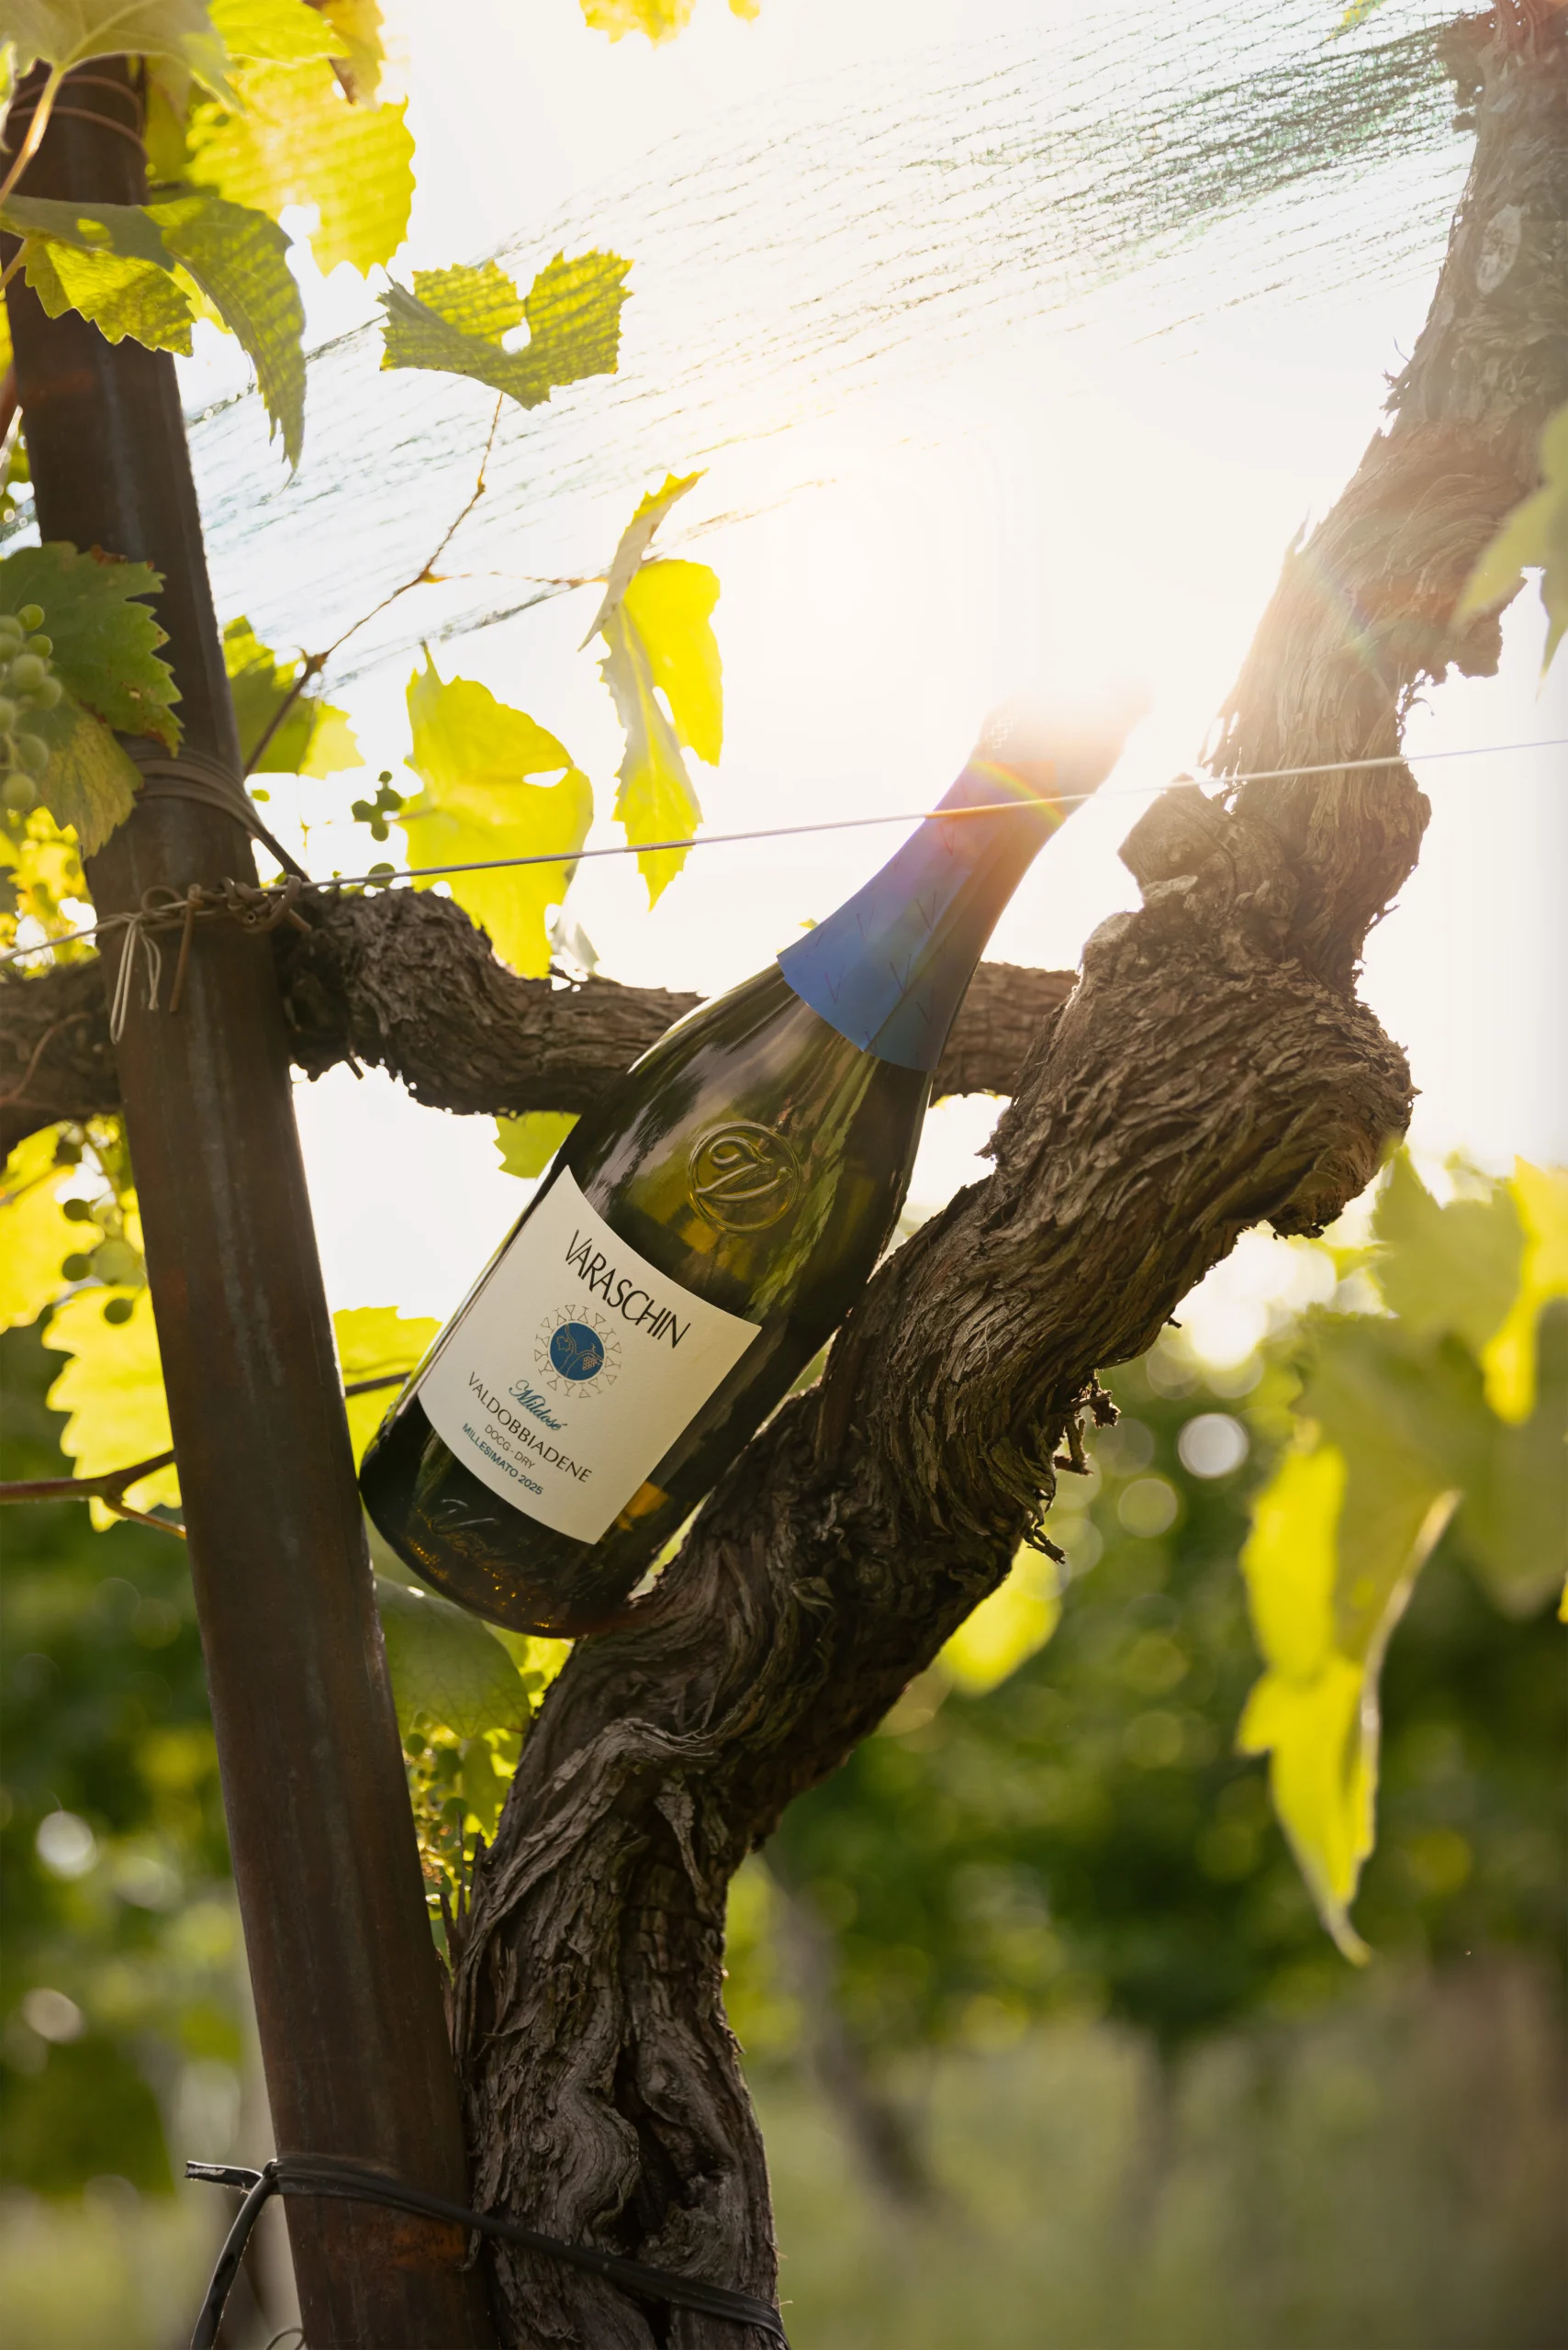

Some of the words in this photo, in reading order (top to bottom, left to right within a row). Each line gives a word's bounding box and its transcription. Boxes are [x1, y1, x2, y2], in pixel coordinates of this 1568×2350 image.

[566, 1229, 691, 1348] VARASCHIN
[468, 1371, 592, 1483] VALDOBBIADENE
[509, 1380, 567, 1430] Mildosé
[462, 1423, 519, 1478] MILLESIMATO
[518, 1474, 543, 1495] 2025
[484, 1424, 511, 1451] DOCG
[513, 1451, 535, 1469] DRY
